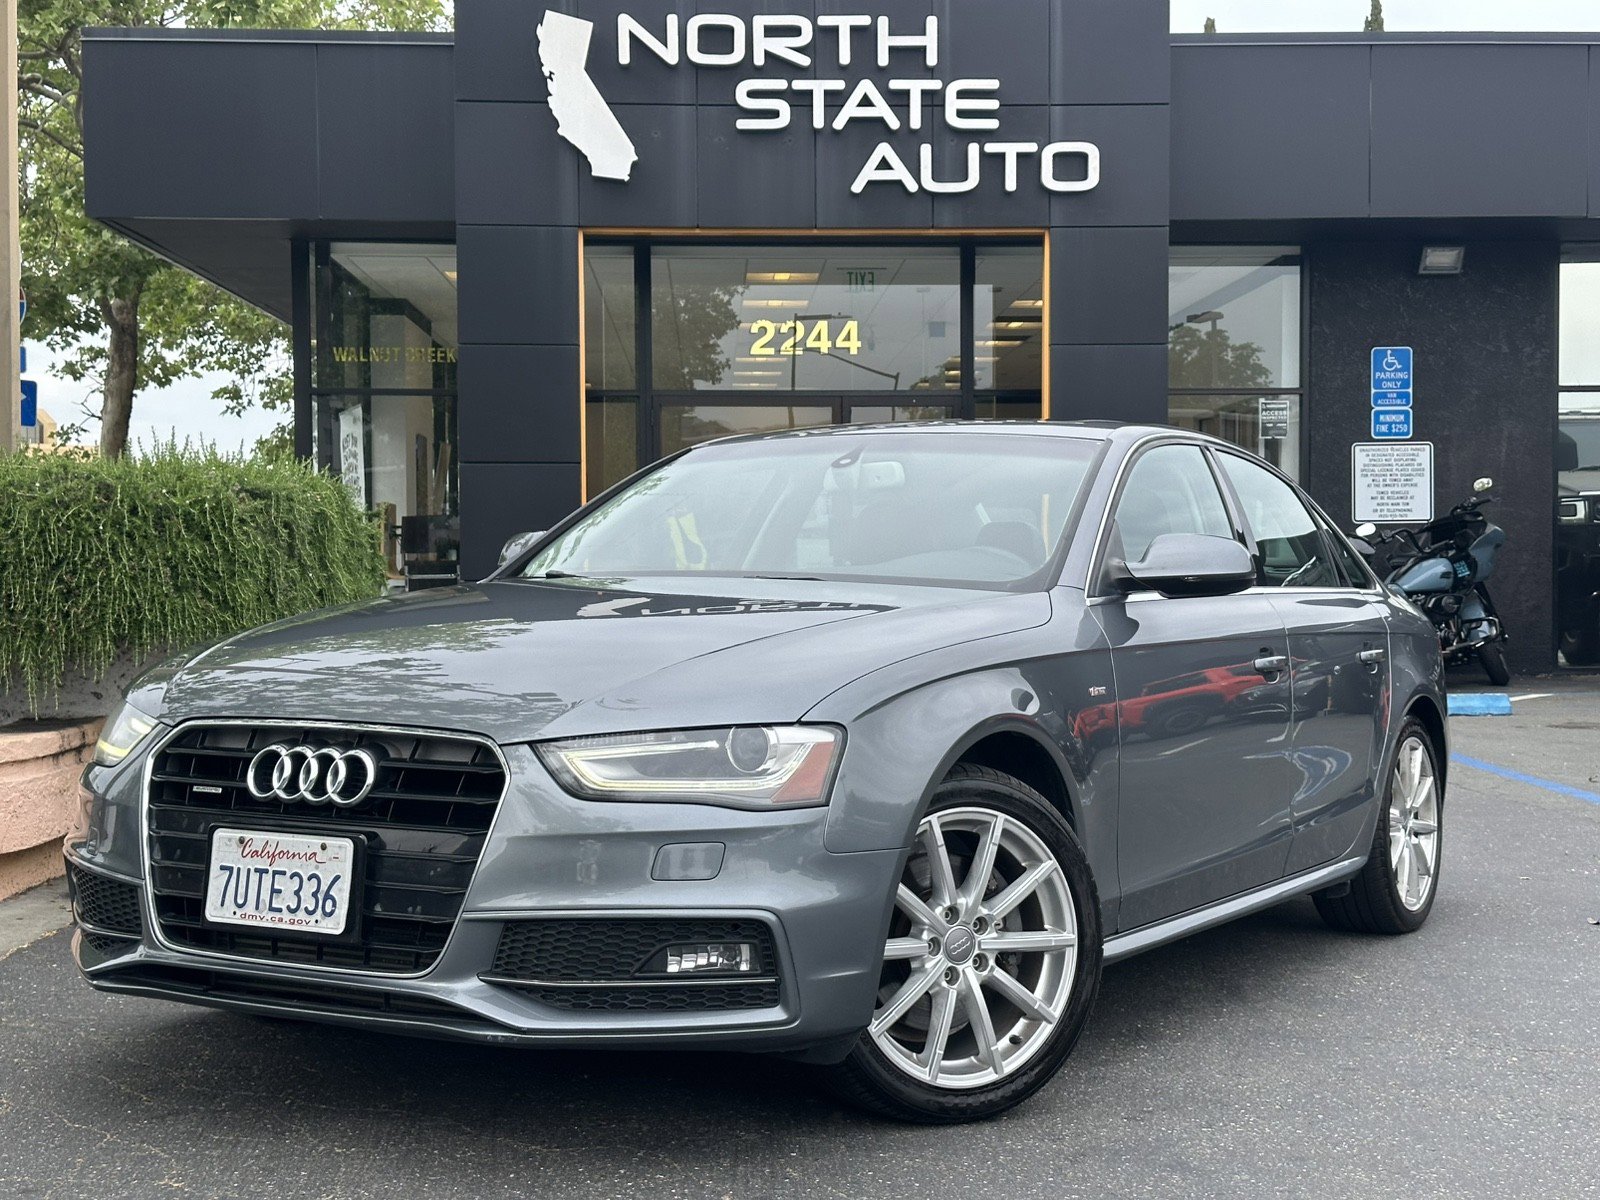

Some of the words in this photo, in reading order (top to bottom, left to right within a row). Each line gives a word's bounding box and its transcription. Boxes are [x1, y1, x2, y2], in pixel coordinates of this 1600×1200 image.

[617, 13, 938, 67] NORTH
[735, 79, 1000, 130] STATE
[850, 142, 1100, 194] AUTO
[750, 319, 862, 355] 2244
[333, 346, 400, 362] WALNUT
[404, 347, 457, 363] CREEK
[1375, 371, 1408, 380] PARKING
[1376, 424, 1389, 432] FINE
[1392, 424, 1408, 432] $250
[241, 837, 326, 866] California
[219, 864, 342, 918] 7UTE336
[240, 912, 311, 926] dmv.ca.gov
